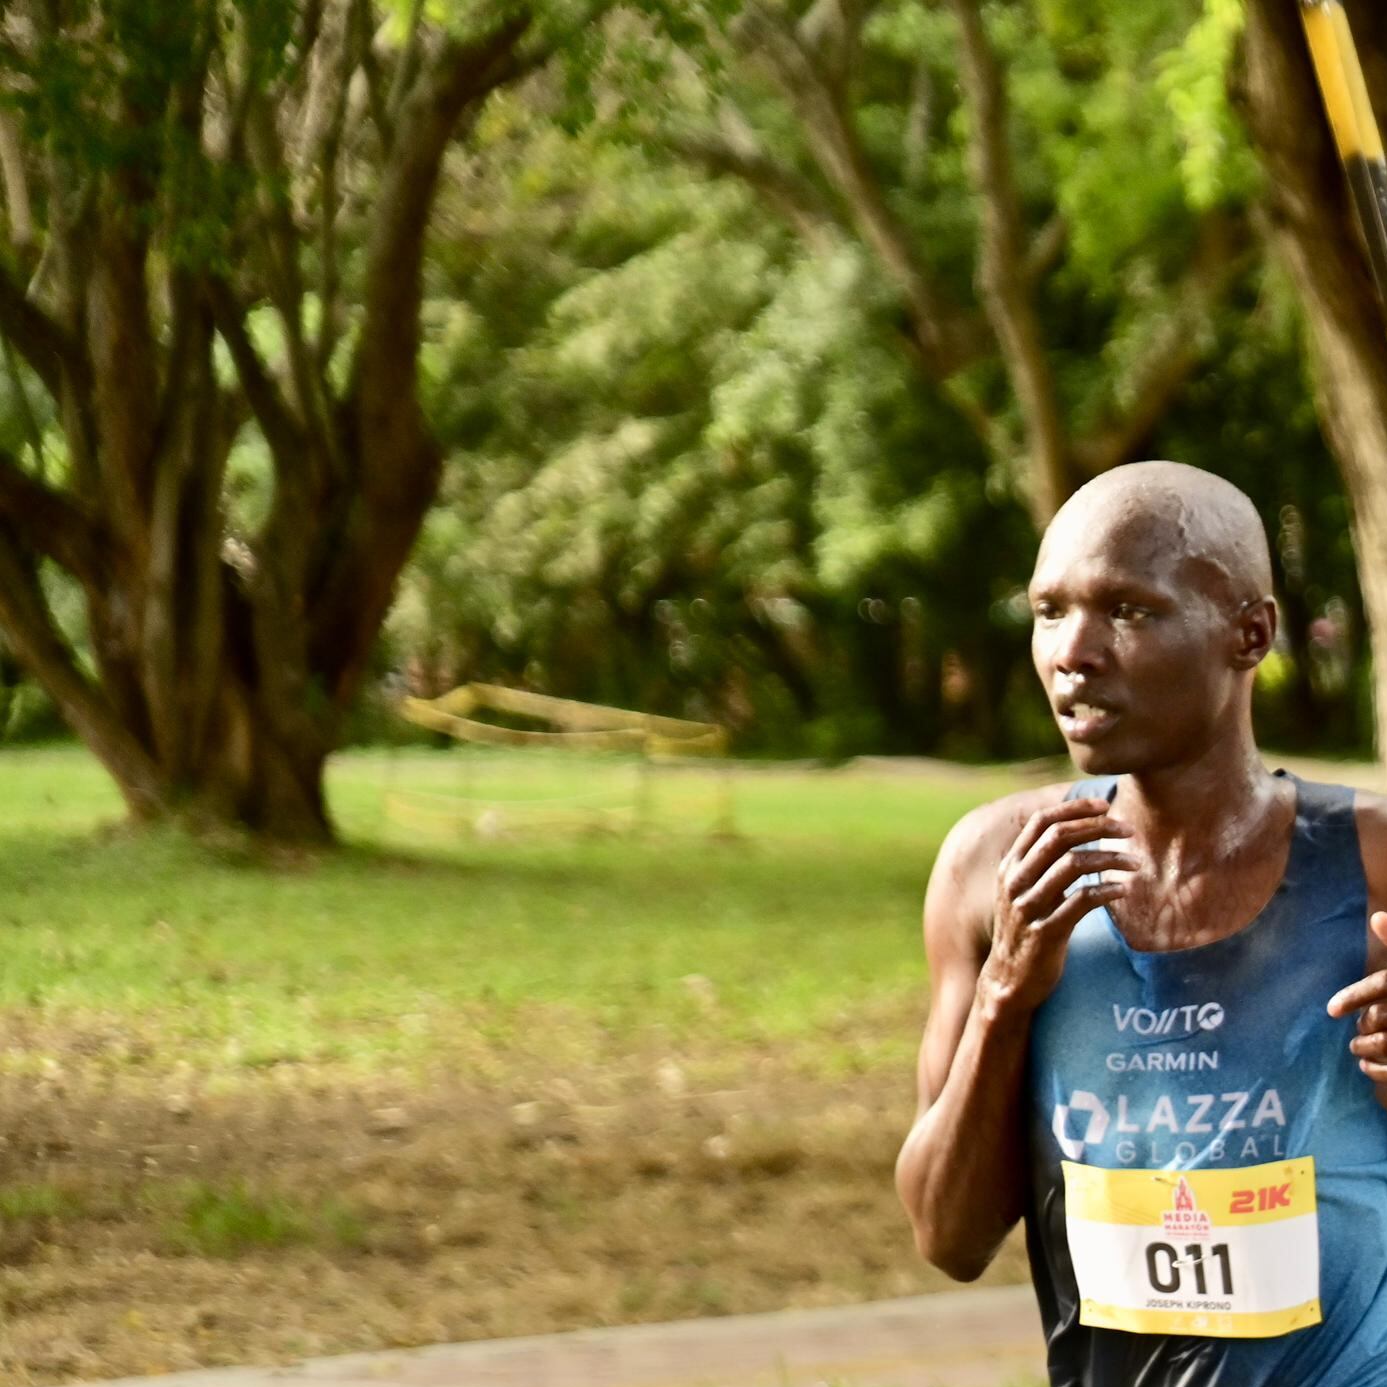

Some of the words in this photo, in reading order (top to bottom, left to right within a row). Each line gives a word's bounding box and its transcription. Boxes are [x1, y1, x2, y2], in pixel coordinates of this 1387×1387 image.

[1106, 1051, 1219, 1072] GARMIN
[1117, 1089, 1286, 1133] LAZZA
[1115, 1134, 1285, 1164] GLOBAL
[1229, 1183, 1292, 1214] 21K
[1164, 1213, 1208, 1222] MEDIA
[1145, 1241, 1234, 1295] 011
[1146, 1299, 1183, 1308] JOSEPH
